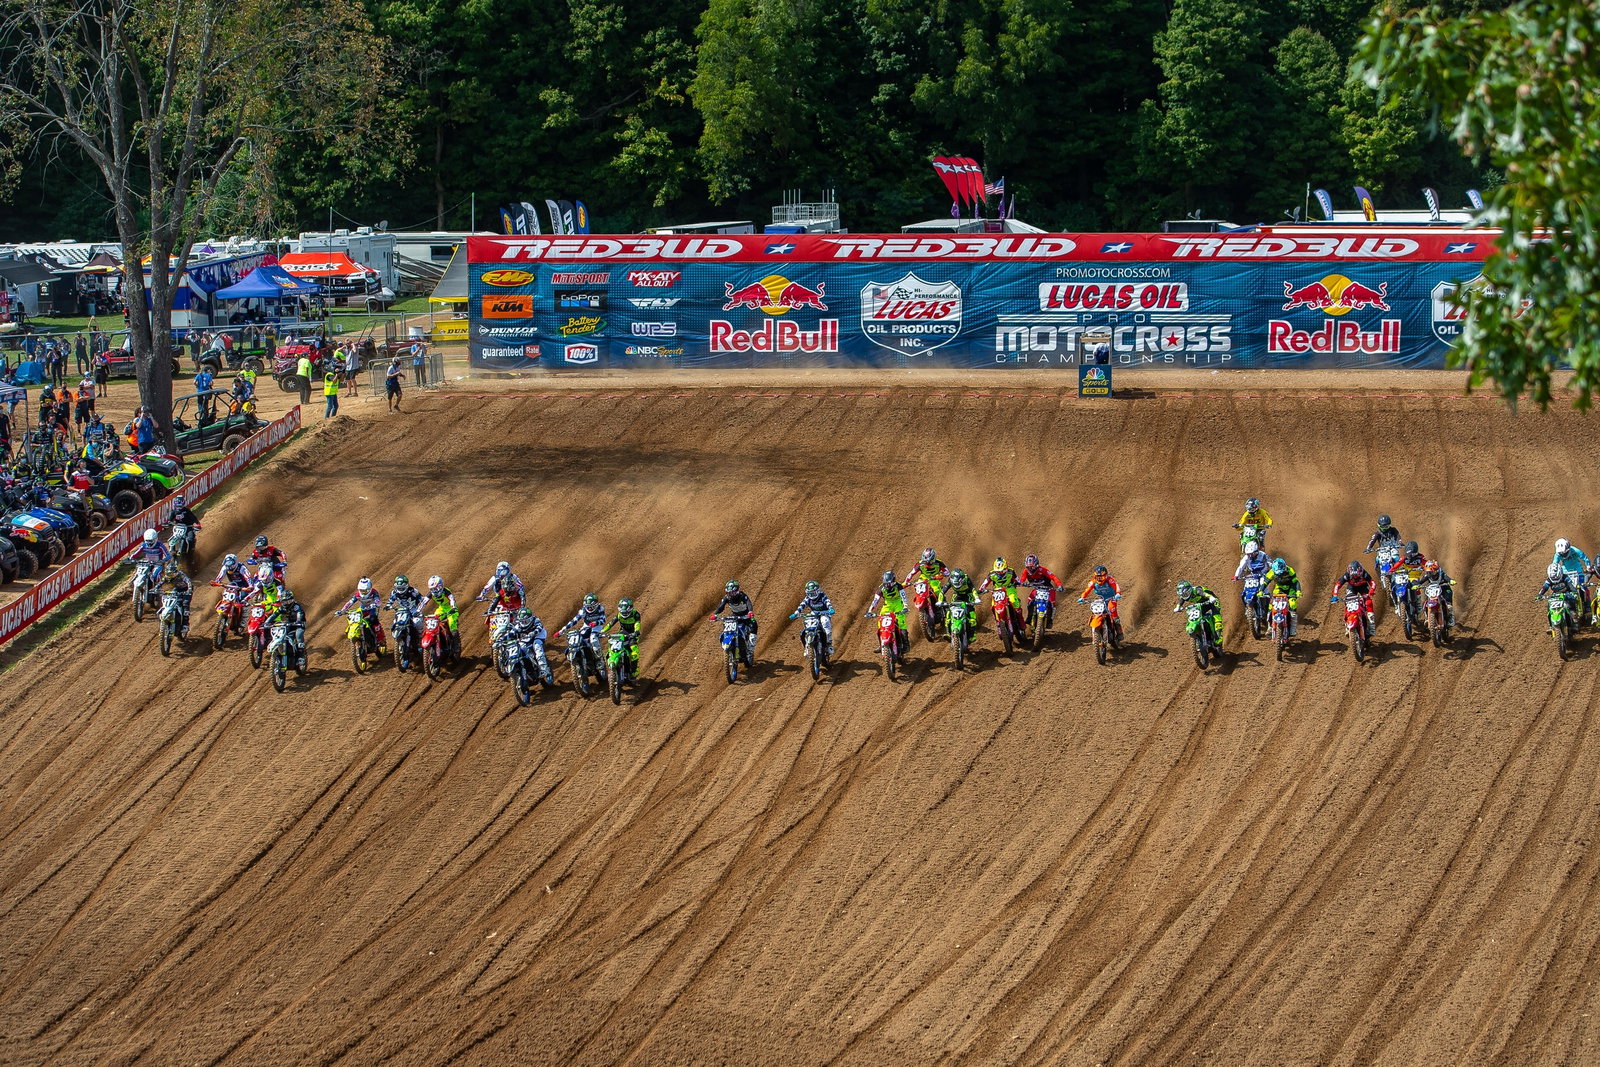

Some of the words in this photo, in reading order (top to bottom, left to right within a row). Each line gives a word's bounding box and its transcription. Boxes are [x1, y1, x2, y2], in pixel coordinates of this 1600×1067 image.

[488, 239, 743, 259] REDBUD
[821, 238, 1077, 257] REDBUD
[1159, 237, 1420, 257] REDBUD
[482, 271, 535, 282] FMF
[1056, 268, 1171, 278] PROMOTOCROSS.COM
[1046, 285, 1134, 309] LUCAS
[1139, 285, 1183, 309] OIL
[492, 301, 523, 312] KTM
[872, 301, 956, 319] LUCAS
[568, 316, 601, 327] Battery
[1082, 314, 1146, 323] PRO
[560, 324, 597, 338] Tender
[631, 322, 677, 337] WPS
[867, 325, 888, 334] OIL
[891, 325, 957, 334] PRODUCTS
[1438, 325, 1459, 335] OIL
[709, 319, 774, 353] Red
[776, 318, 839, 353] Bull
[1268, 319, 1335, 353] Red
[1337, 319, 1401, 354] Bull
[900, 338, 925, 347] INC.
[482, 346, 524, 359] guaranteed
[569, 348, 594, 359] 100%
[637, 346, 658, 355] NBC
[996, 354, 1232, 363] CHAMPONSHIP
[1082, 377, 1110, 387] Sports
[73, 552, 93, 586] LUCAS
[93, 546, 103, 572] OIL
[37, 576, 60, 611] LUCAS
[60, 569, 72, 595] OIL
[222, 592, 235, 601] 30
[23, 594, 35, 621] OIL
[724, 622, 737, 632] 239
[568, 635, 580, 645] 41
